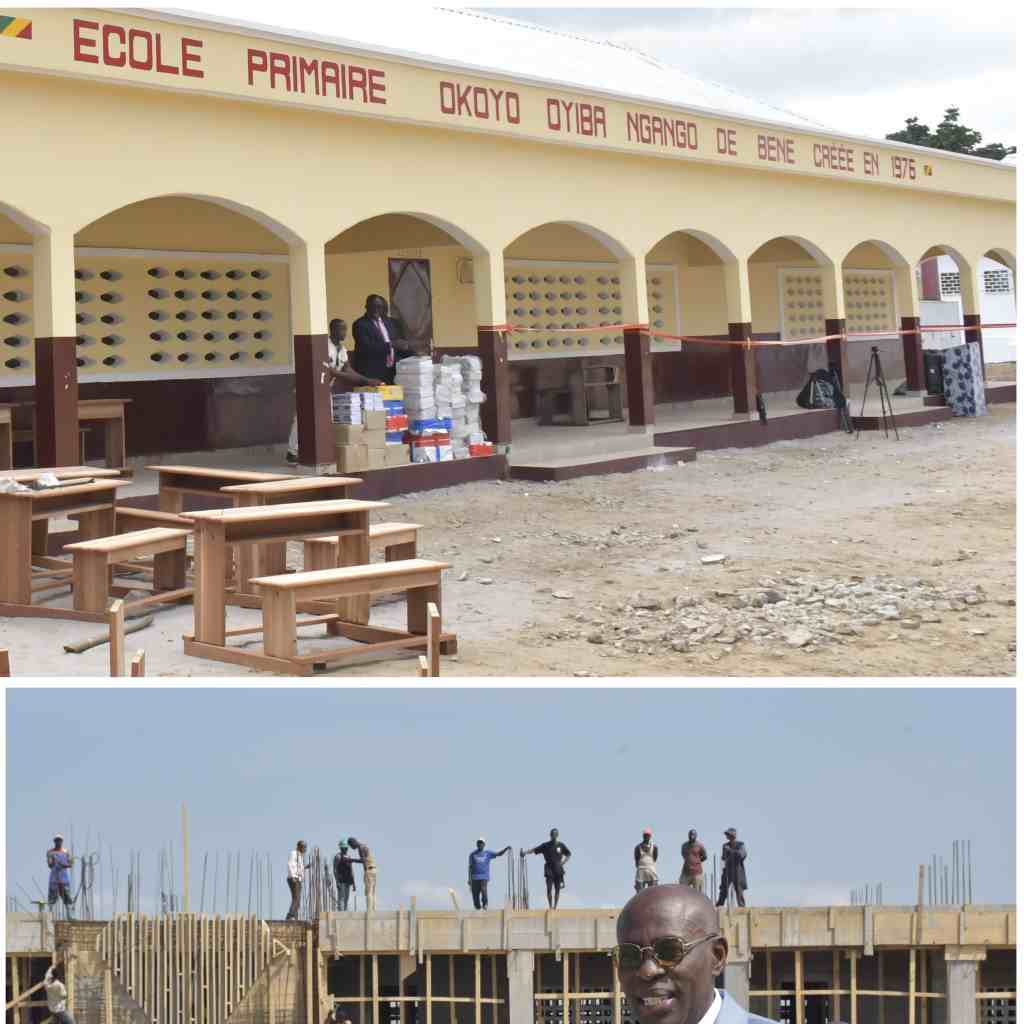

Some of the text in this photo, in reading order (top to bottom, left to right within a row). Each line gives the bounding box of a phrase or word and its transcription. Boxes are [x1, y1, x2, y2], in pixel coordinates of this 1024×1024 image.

[72, 18, 204, 79] ECOLE
[247, 48, 387, 105] PRIMAIRE
[440, 81, 520, 124] OKOYO
[546, 98, 607, 138] OYIBA
[626, 112, 698, 150] NGANGO
[717, 128, 737, 156] DE
[758, 135, 795, 164] BENE
[864, 151, 880, 176] EN
